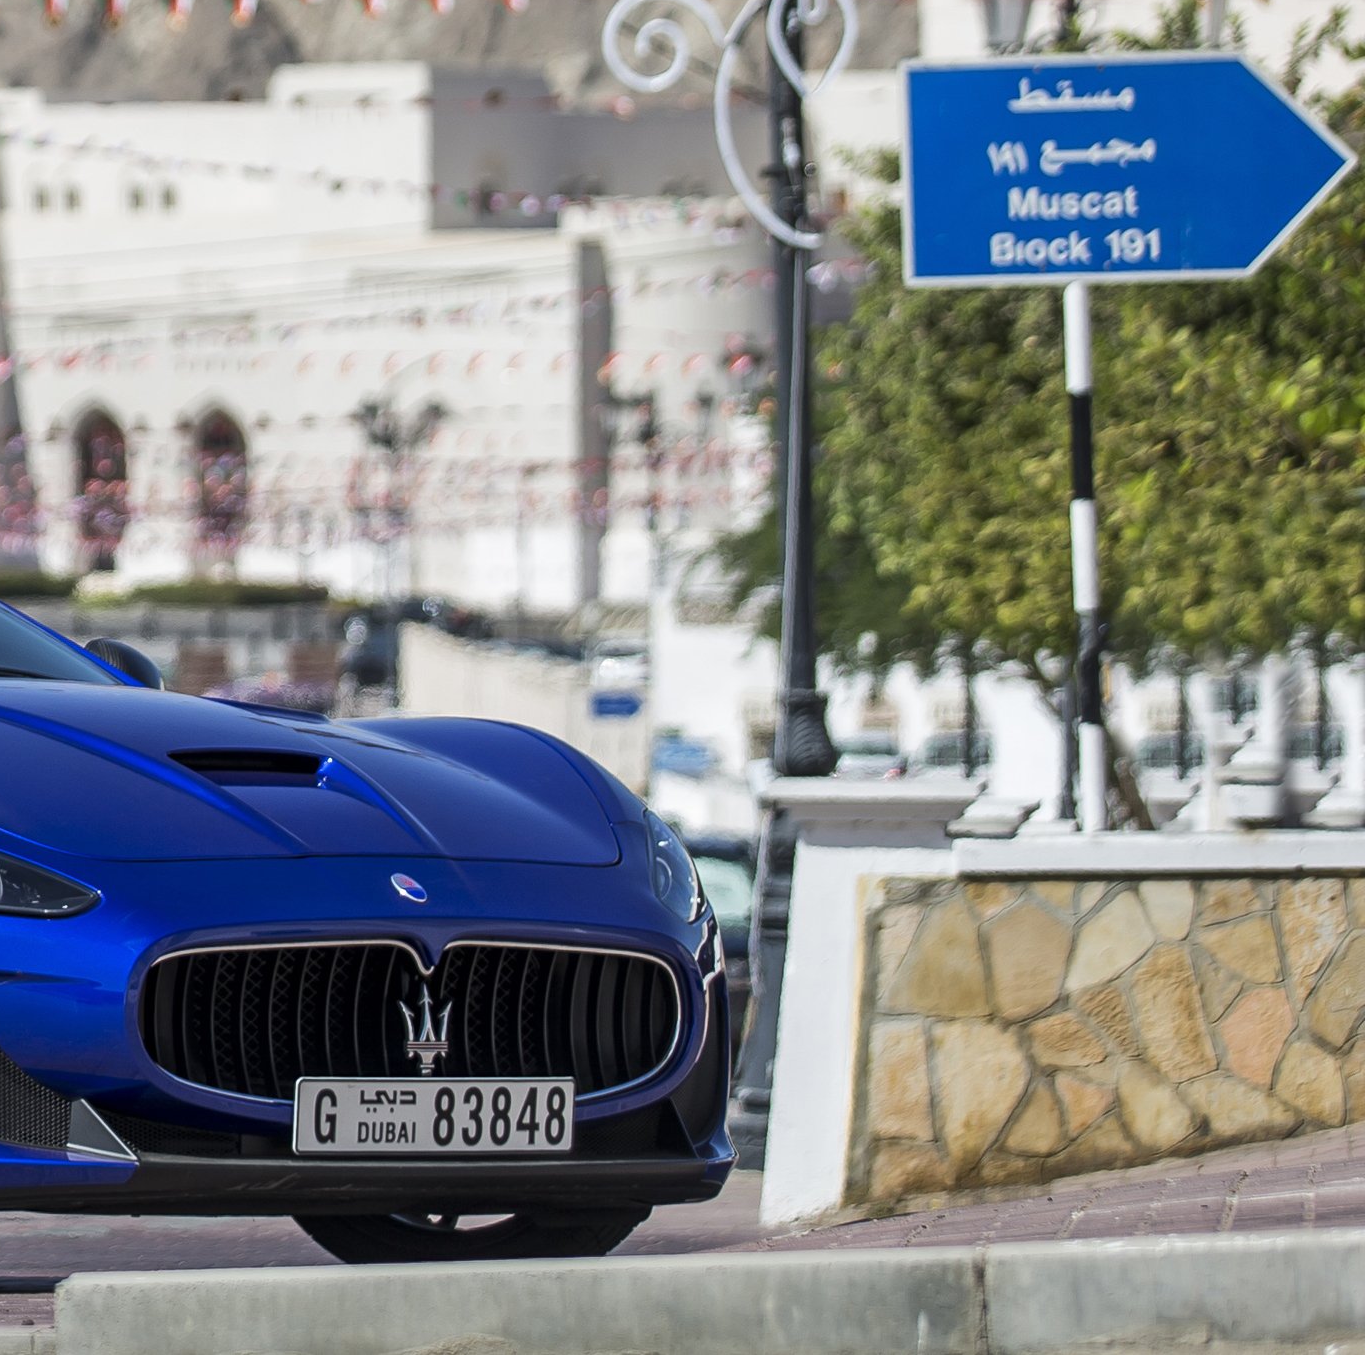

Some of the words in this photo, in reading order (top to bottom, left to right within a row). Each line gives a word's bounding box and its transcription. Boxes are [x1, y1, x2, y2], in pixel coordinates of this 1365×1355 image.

[1008, 78, 1136, 113] مسقط
[1008, 185, 1138, 220] Muscat
[1105, 228, 1161, 262] 191
[314, 1088, 338, 1145] G
[432, 1086, 566, 1147] 83848
[359, 1089, 417, 1114] دبي
[357, 1121, 416, 1144] DUBAI
